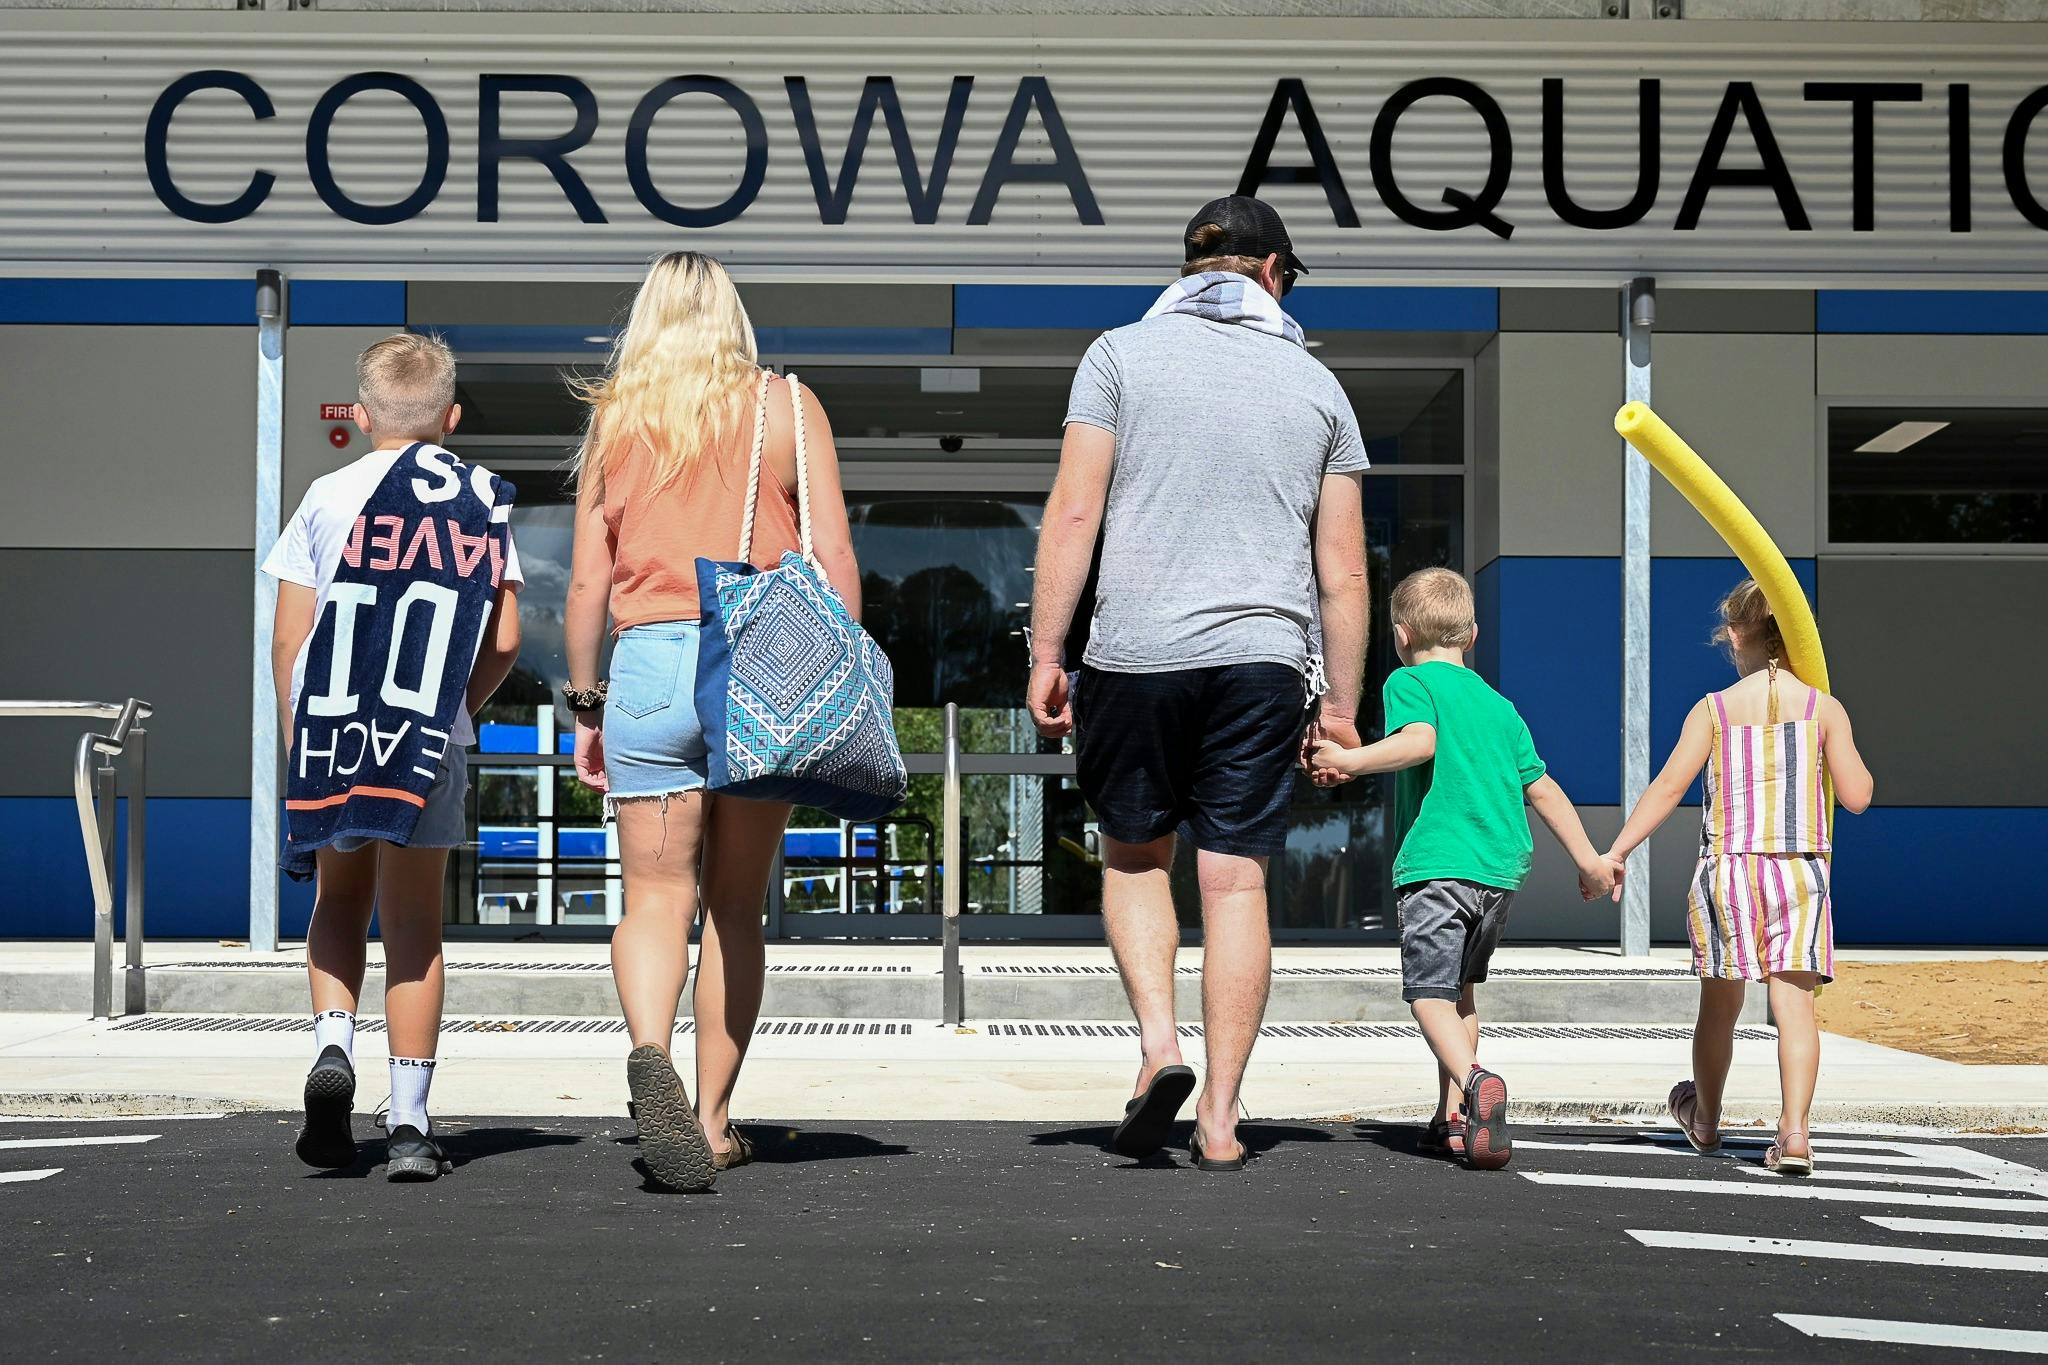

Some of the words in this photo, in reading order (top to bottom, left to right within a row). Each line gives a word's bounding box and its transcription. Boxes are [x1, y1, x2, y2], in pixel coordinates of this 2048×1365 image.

[145, 70, 1105, 228] COROWA
[325, 406, 356, 418] FIRE
[307, 580, 493, 717] DI
